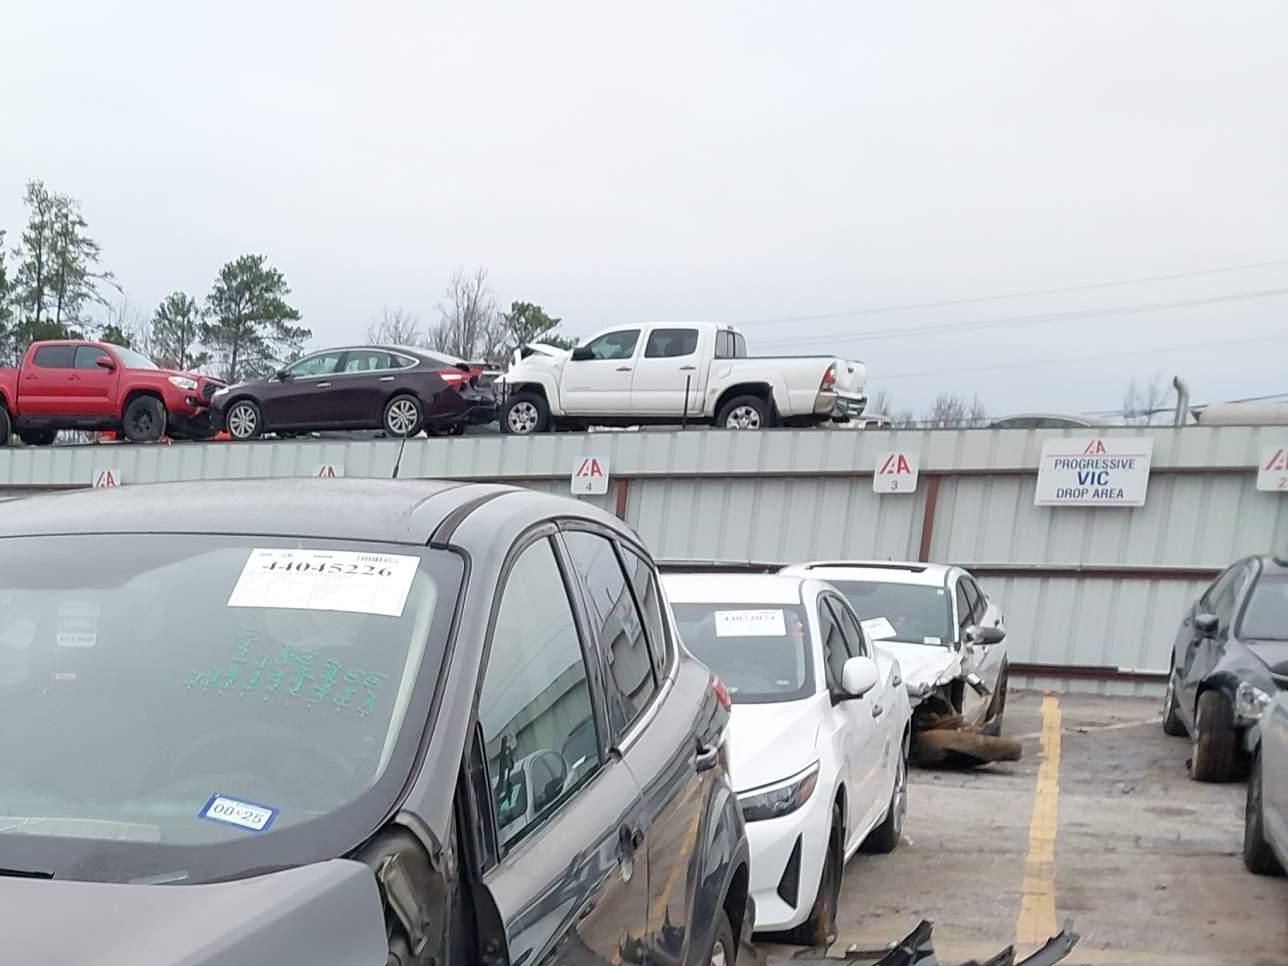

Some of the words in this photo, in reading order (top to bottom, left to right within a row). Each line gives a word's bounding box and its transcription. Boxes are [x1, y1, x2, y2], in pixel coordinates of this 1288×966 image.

[1054, 459, 1136, 469] PROGRESSIVE
[1077, 471, 1109, 486] VIC
[890, 480, 899, 490] 3
[1056, 488, 1089, 499] DROP
[1092, 488, 1124, 499] AREA
[261, 561, 392, 577] 44045226
